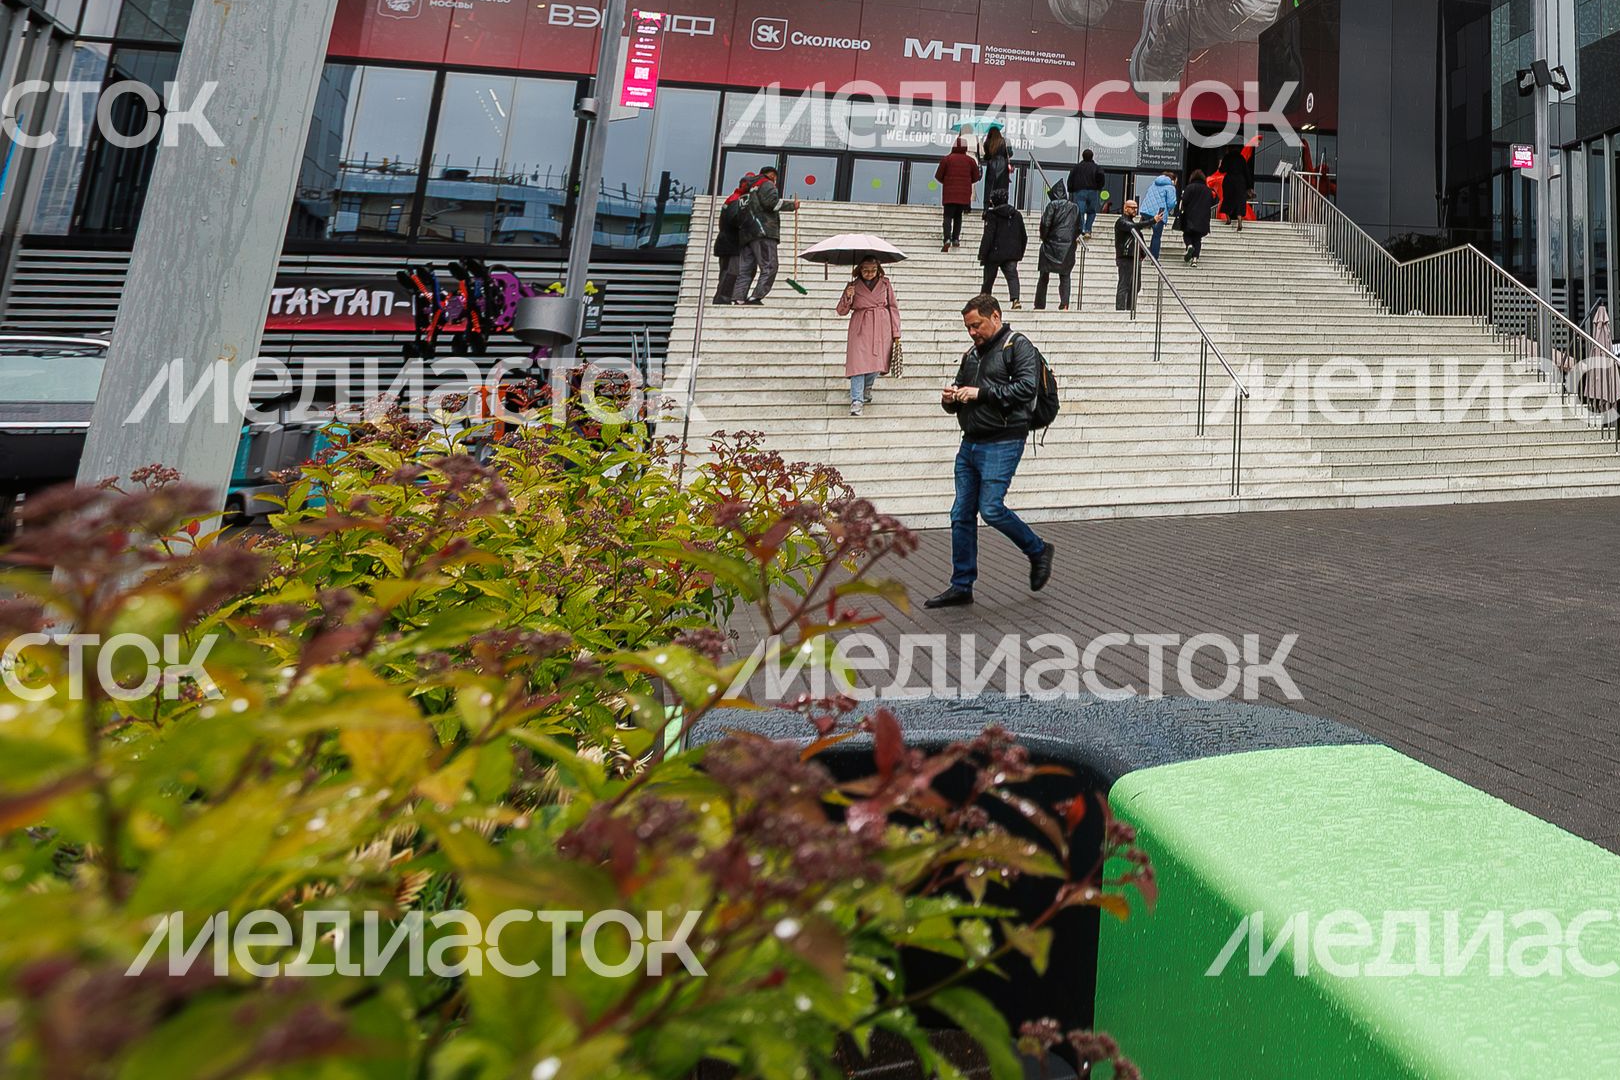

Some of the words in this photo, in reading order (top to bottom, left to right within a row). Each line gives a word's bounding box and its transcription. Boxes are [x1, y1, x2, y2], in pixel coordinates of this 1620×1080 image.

[429, 0, 473, 9] МОСКВЫ
[757, 24, 781, 44] Sk
[791, 31, 871, 52] Сколково
[903, 37, 981, 64] МНП
[985, 45, 1036, 57] Московская
[1036, 51, 1066, 59] неделя
[984, 51, 1076, 67] предпринимательства
[984, 58, 1006, 66] 2026
[874, 107, 932, 128] ДОБРО
[886, 128, 937, 144] WELCOME
[940, 133, 952, 144] TO
